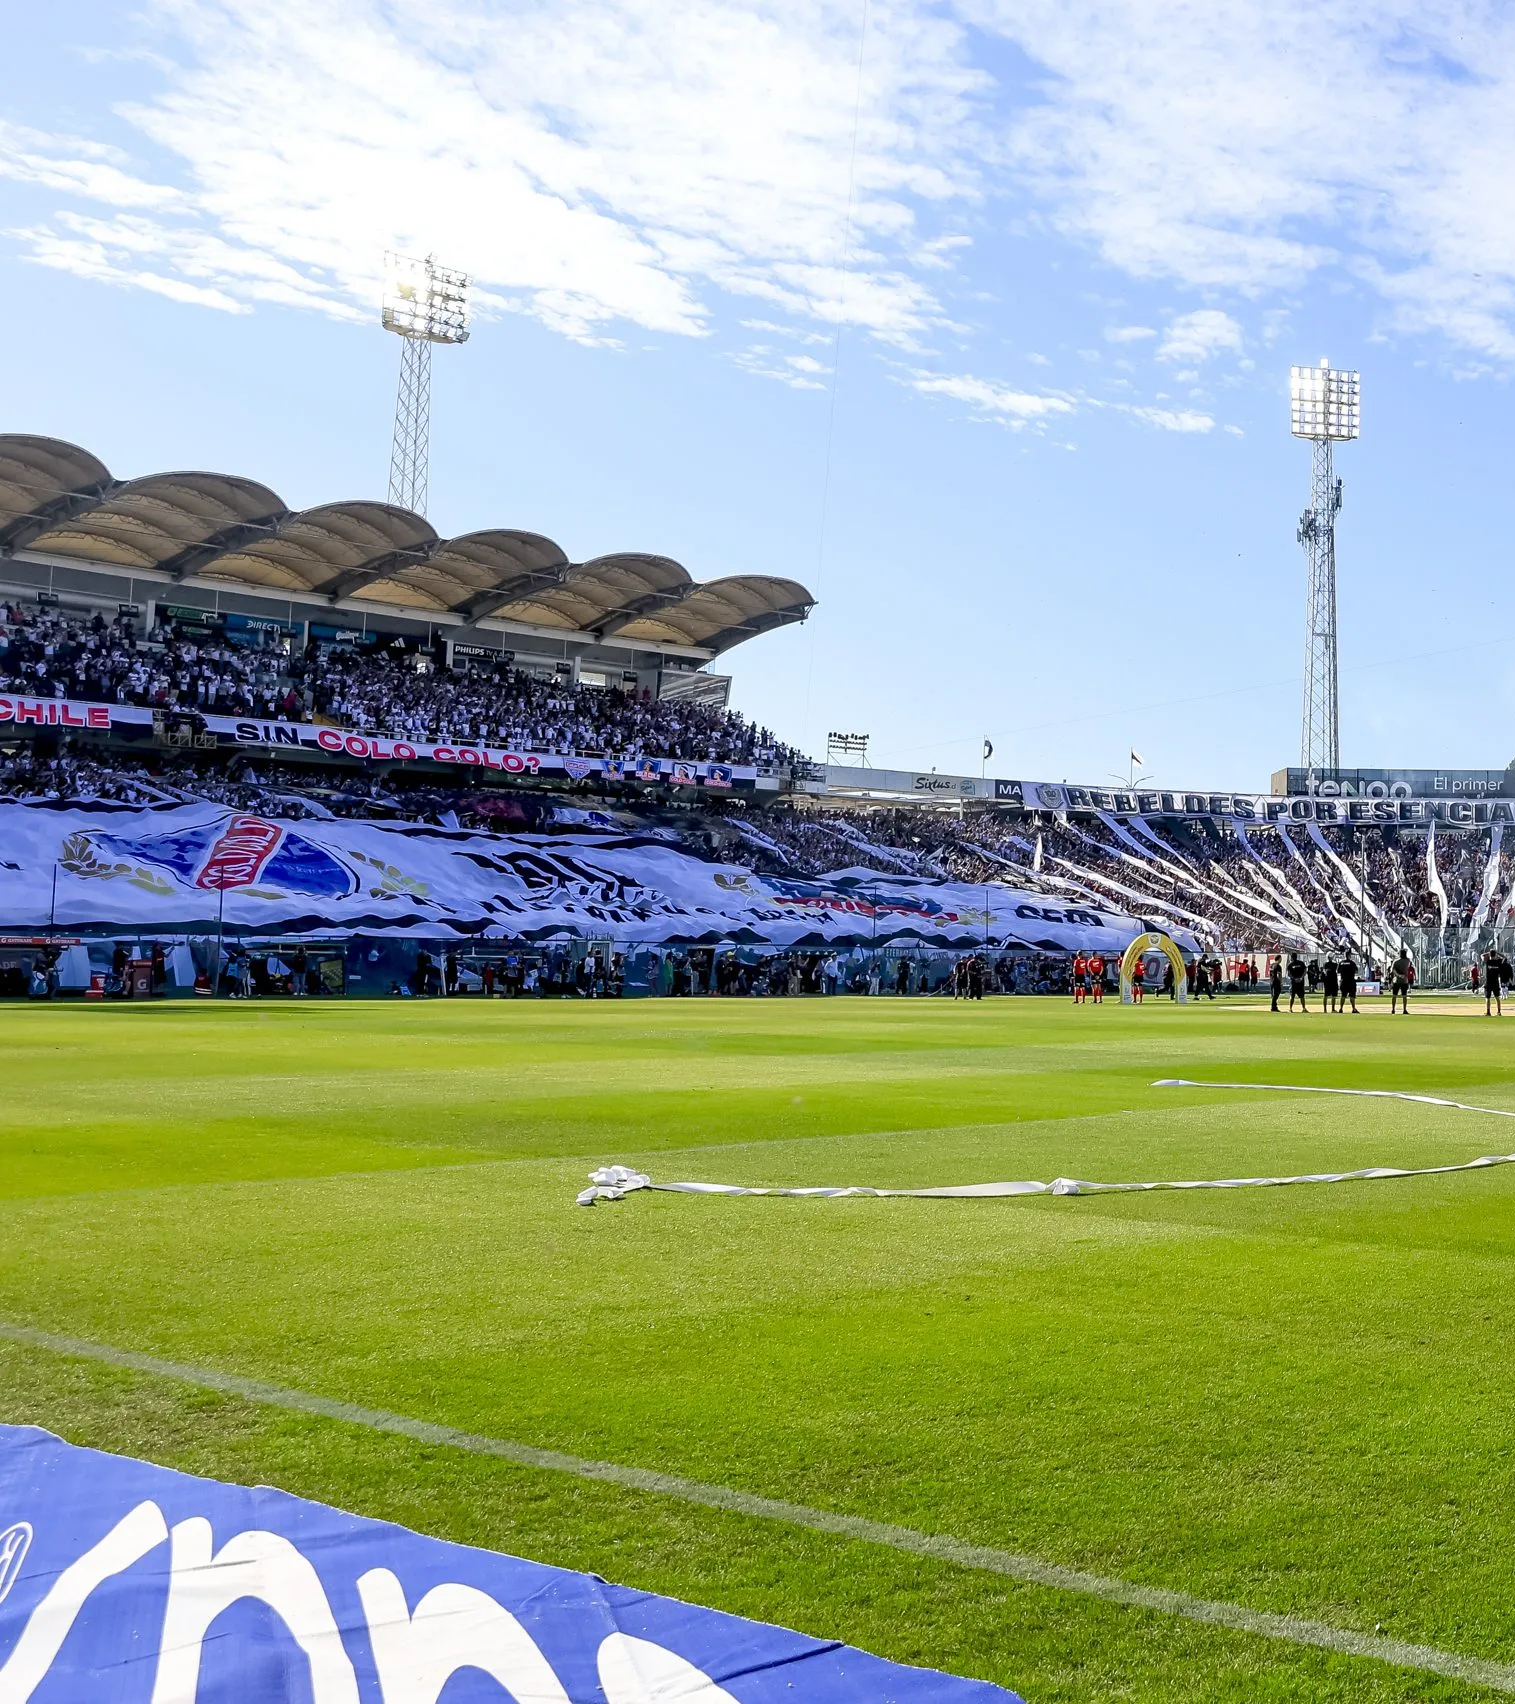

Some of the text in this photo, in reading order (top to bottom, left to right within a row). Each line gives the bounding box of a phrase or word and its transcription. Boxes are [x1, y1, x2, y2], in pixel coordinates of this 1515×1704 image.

[455, 645, 485, 656] PHILIPS
[235, 723, 540, 774] SIN COLO COLO?
[1434, 777, 1503, 793] El primer
[1066, 786, 1515, 826] REBELDES POR ESENCIA
